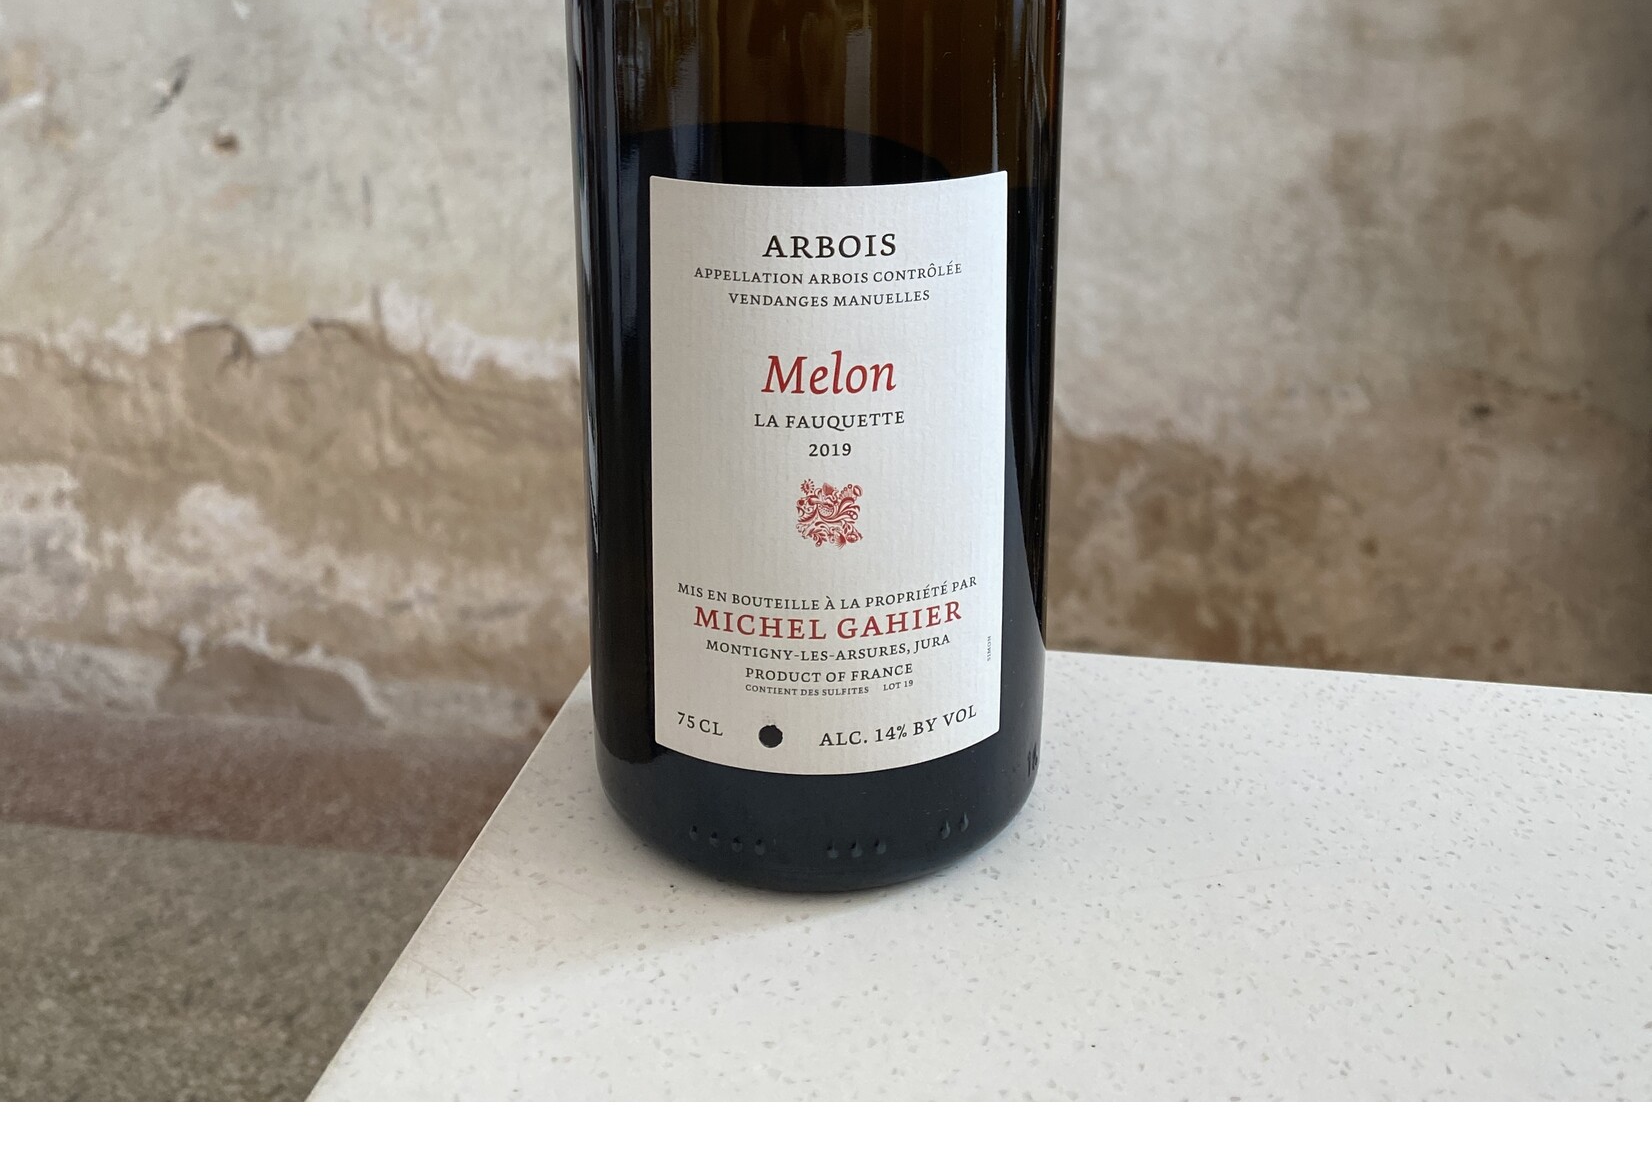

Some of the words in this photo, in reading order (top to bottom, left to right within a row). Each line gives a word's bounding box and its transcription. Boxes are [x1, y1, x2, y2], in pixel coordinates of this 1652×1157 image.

[762, 233, 896, 259] ARBOIS
[694, 268, 803, 284] APPELLATION
[808, 272, 868, 284] ARBOIS
[873, 260, 961, 282] CONTRÔLÉE
[728, 293, 828, 307] VENDANGES
[833, 290, 929, 306] MANUELLES
[761, 350, 896, 395] Melon
[754, 414, 779, 427] LA
[785, 411, 904, 431] FAUQUETTE
[809, 443, 851, 457] 2019
[678, 583, 703, 597] MIS
[708, 590, 727, 602] EN
[732, 594, 819, 610] BOUTEILLE
[824, 596, 835, 610] À
[840, 599, 860, 609] LA
[865, 583, 948, 608] PROPRIÉTÉ
[952, 577, 976, 592] PAR
[694, 605, 827, 639] MICHEL
[837, 600, 961, 640] GAHIER
[706, 638, 910, 661] MONTIGNY-LES-ARSURES,
[914, 634, 950, 653] JURA
[746, 668, 821, 682] PRODUCT
[826, 672, 845, 682] OF
[851, 663, 913, 682] FRANCE
[746, 684, 797, 695] CONTIENT
[822, 687, 869, 696] SULFITES
[883, 682, 901, 691] LOT
[678, 712, 695, 728] 75
[700, 719, 723, 736] CL
[819, 731, 867, 746] ALC.
[875, 724, 907, 742] 14%
[913, 717, 937, 736] BY
[943, 705, 976, 726] VOL
